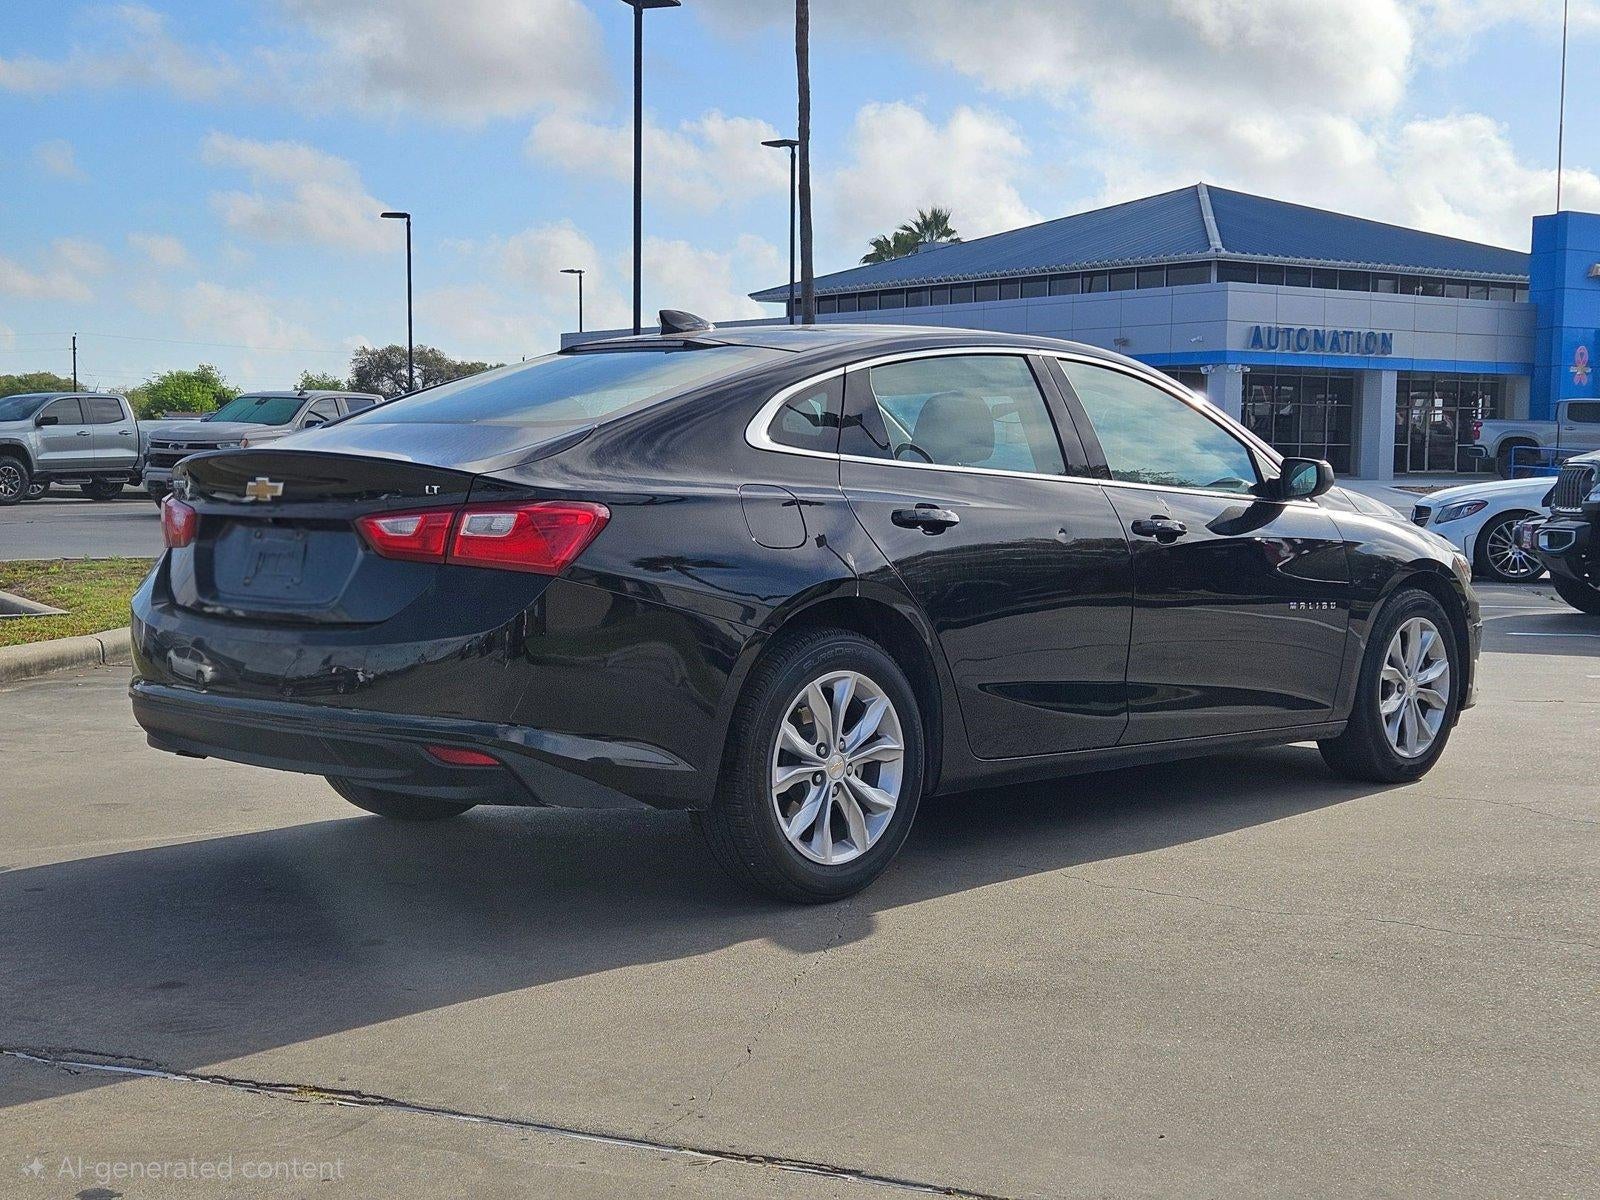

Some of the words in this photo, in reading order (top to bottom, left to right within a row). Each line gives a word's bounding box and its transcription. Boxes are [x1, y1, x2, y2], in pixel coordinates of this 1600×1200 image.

[1250, 325, 1393, 356] AUTONATION
[425, 485, 441, 495] LT
[1289, 601, 1337, 610] MALIBU
